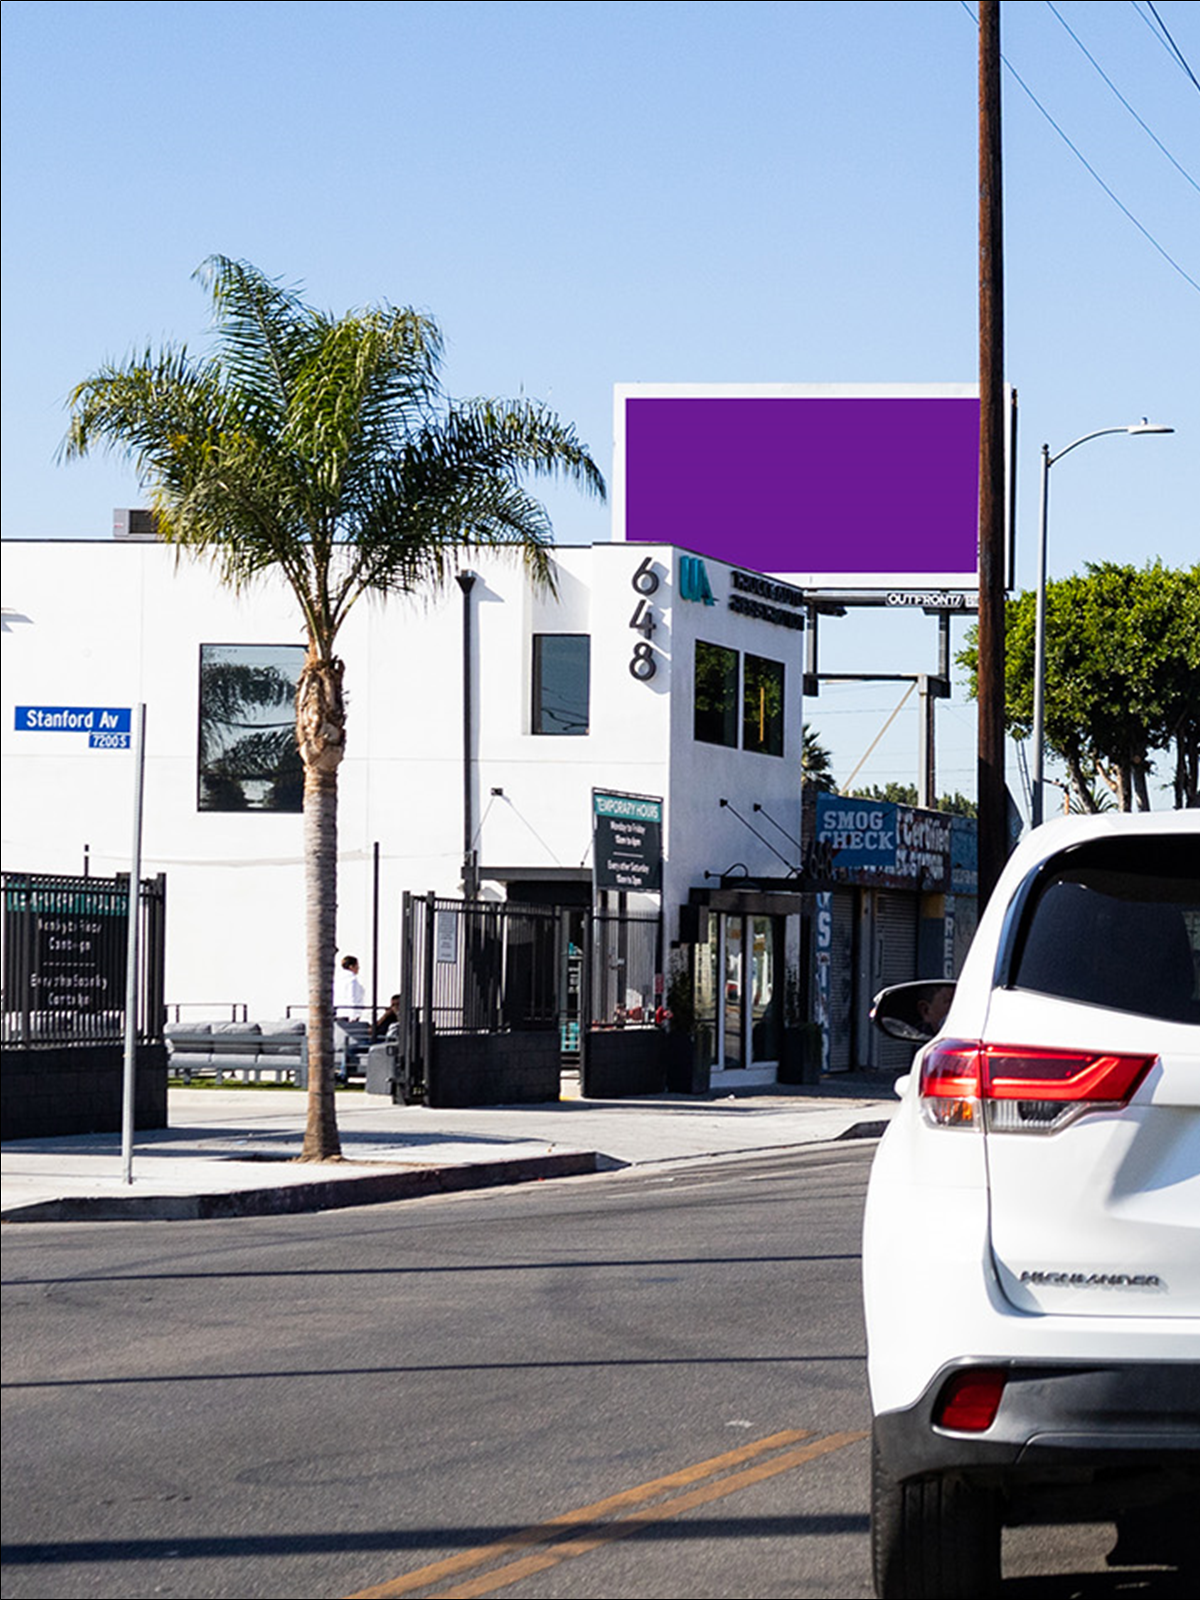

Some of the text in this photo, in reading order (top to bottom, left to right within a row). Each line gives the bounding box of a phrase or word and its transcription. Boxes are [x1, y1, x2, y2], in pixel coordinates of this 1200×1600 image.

[629, 556, 660, 681] 648
[26, 709, 119, 728] Stanford Av
[93, 735, 118, 748] 7200
[596, 797, 659, 819] TEMPORARY HOURS
[823, 810, 884, 830] SMOG
[819, 831, 894, 850] CHECK
[1020, 1271, 1160, 1287] HIGHLANDER
